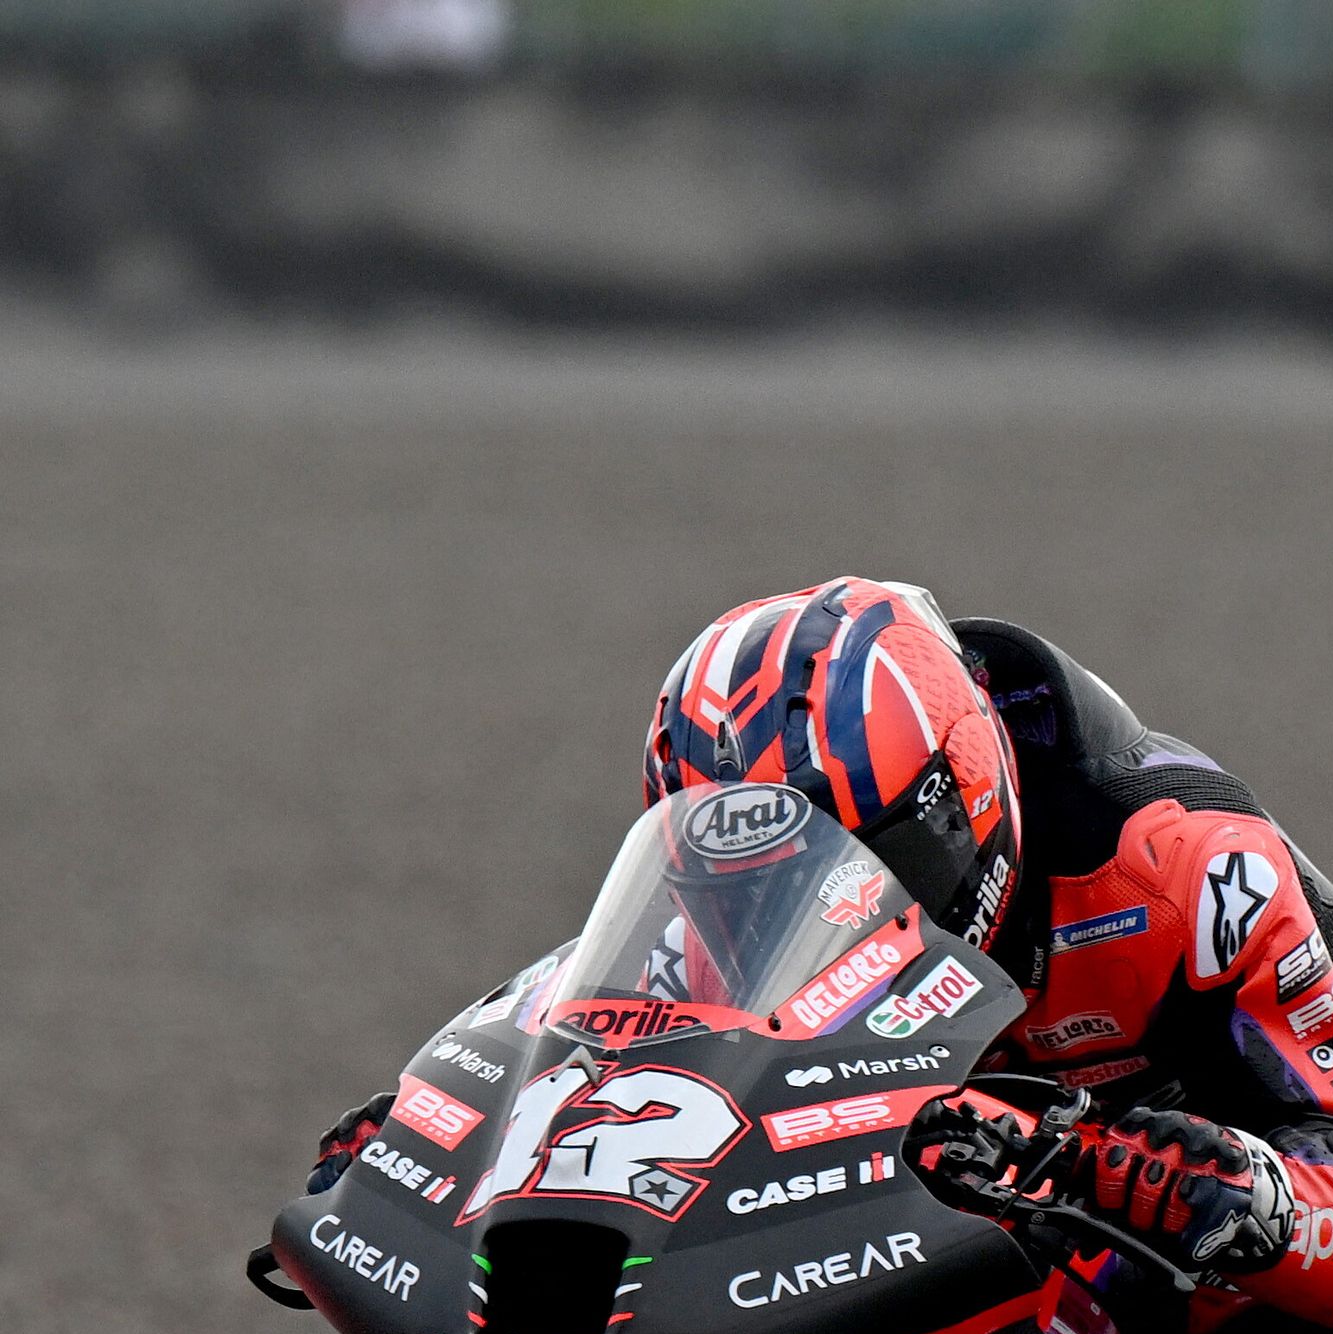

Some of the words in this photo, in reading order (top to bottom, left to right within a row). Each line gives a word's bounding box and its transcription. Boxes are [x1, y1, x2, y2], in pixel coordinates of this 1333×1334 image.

[694, 789, 791, 843] Arai
[917, 774, 951, 821] OAKLEY
[971, 789, 993, 818] 12
[722, 831, 773, 848] HELMET
[821, 862, 868, 902] MAVERICK
[1069, 916, 1138, 942] MICHELIN
[450, 1048, 505, 1084] Marsh
[837, 1054, 940, 1079] Marsh
[396, 1108, 453, 1142] BATTERY
[403, 1088, 476, 1135] BS
[770, 1097, 891, 1139] BS
[779, 1117, 895, 1145] BATTERY
[458, 1064, 746, 1216] 12
[359, 1140, 431, 1190] CASE
[727, 1166, 847, 1215] CASE
[309, 1213, 421, 1303] CAREAR
[729, 1230, 927, 1308] CAREAR
